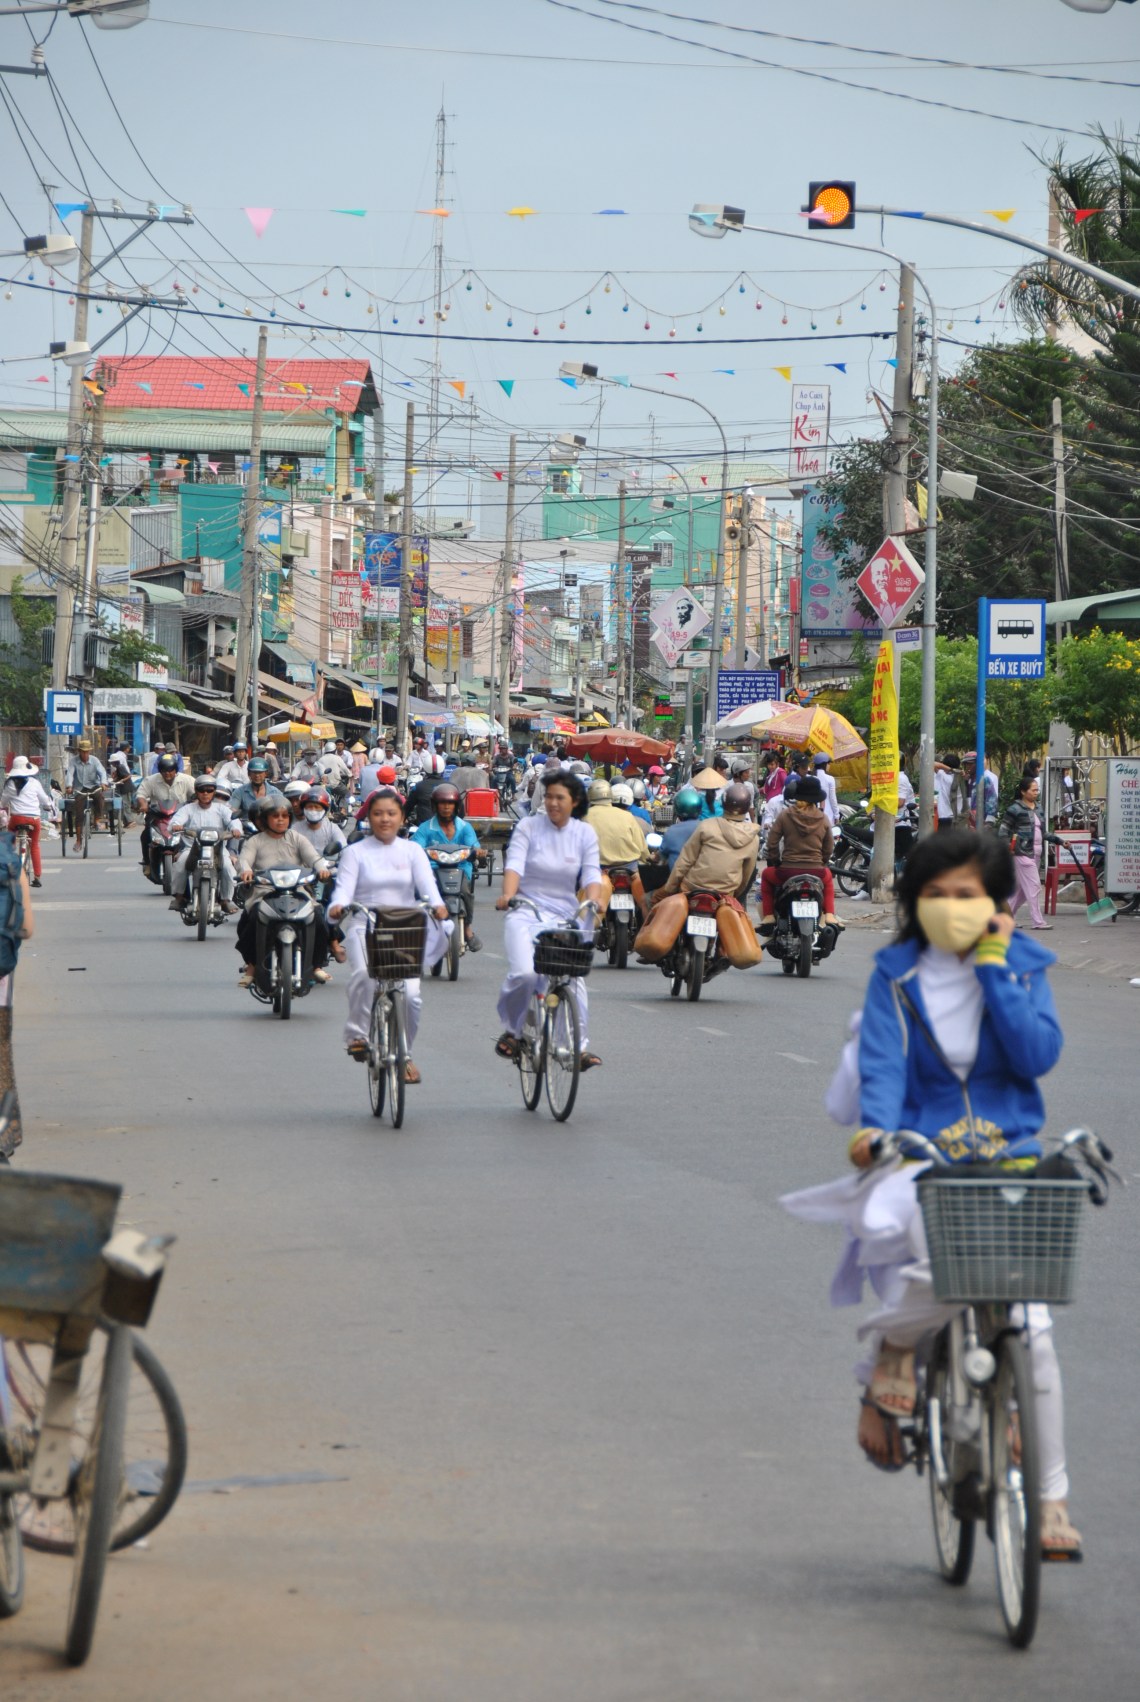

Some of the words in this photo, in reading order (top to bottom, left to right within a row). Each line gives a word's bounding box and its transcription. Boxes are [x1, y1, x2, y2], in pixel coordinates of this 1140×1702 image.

[671, 631, 688, 639] 19-5
[988, 657, 1006, 676] BẾN
[1007, 661, 1019, 676] XE
[1020, 658, 1043, 676] BUÝT
